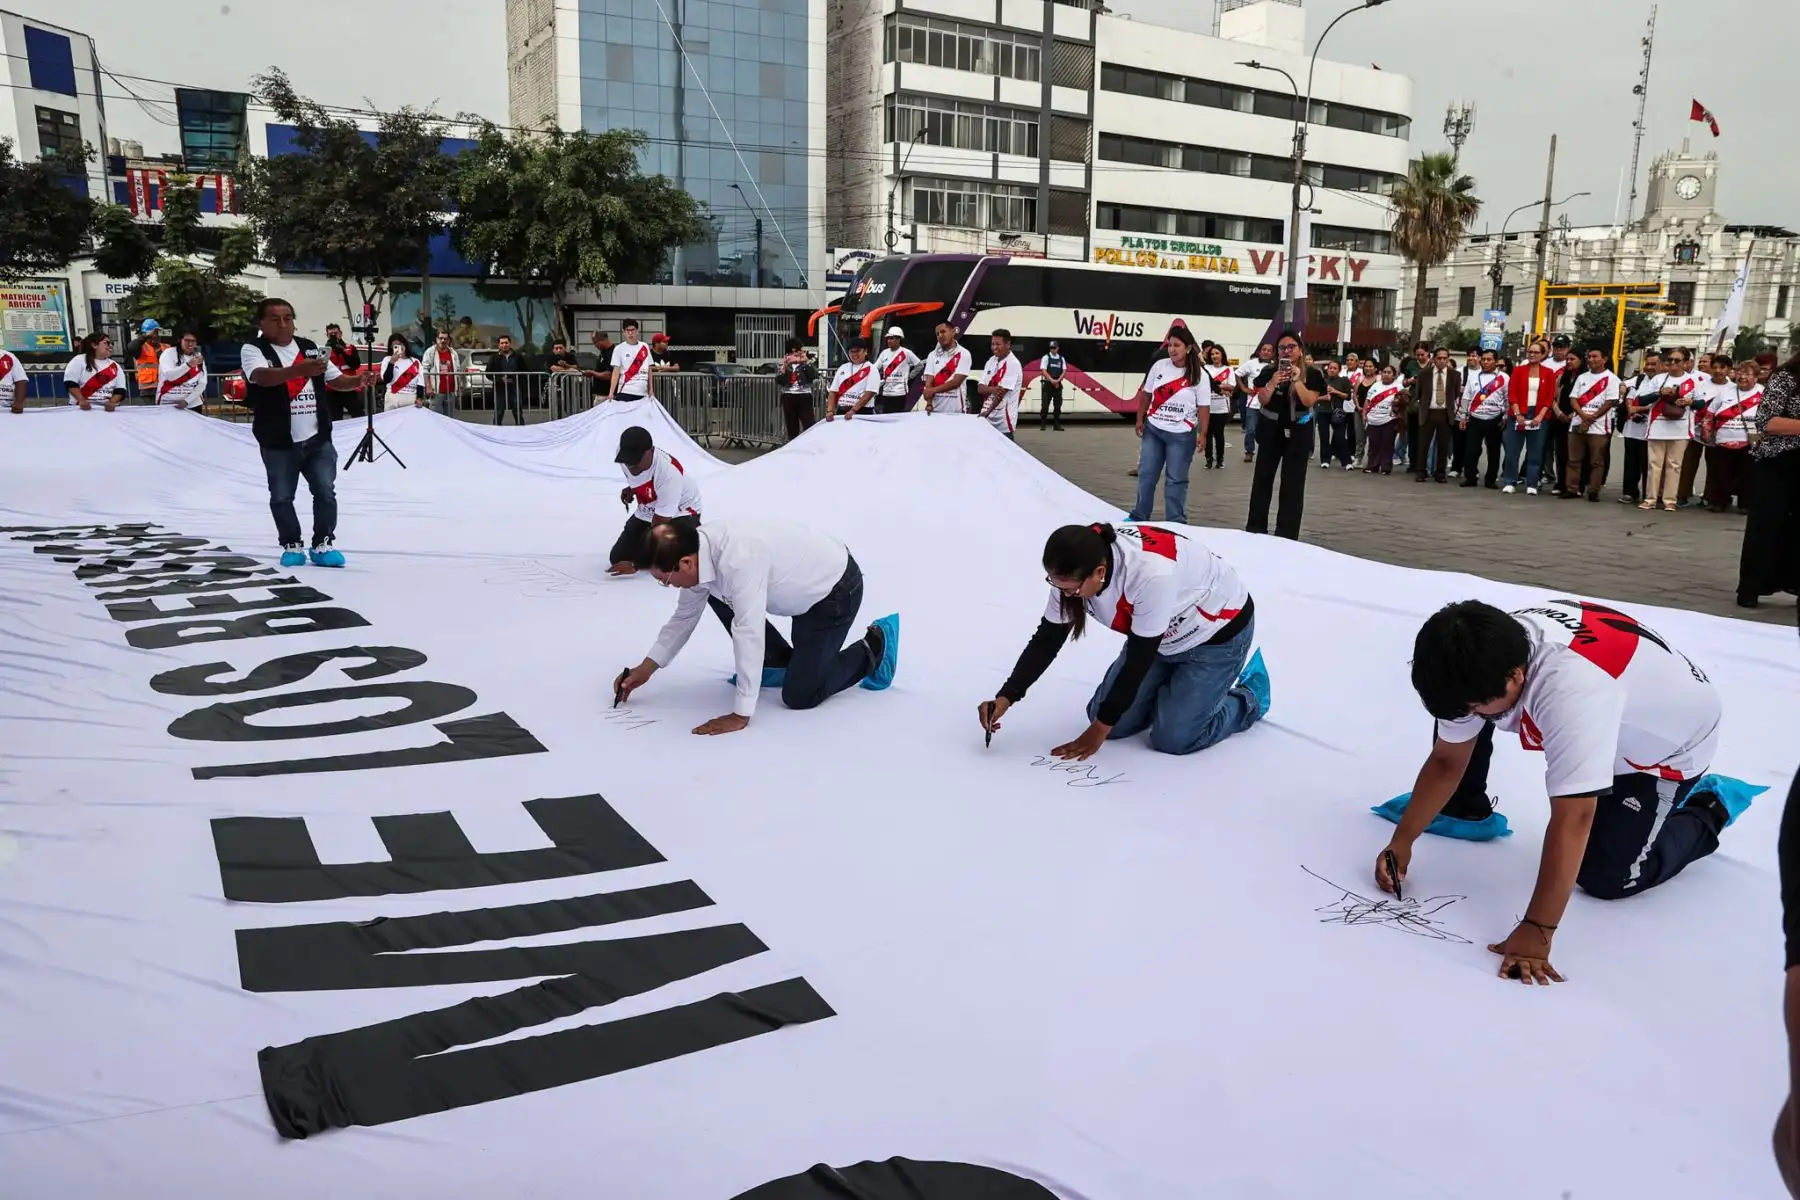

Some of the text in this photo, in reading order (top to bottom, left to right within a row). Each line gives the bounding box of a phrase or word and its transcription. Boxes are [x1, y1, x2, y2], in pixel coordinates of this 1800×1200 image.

[1121, 236, 1222, 256] PLATOS CRIOLLOS
[1095, 247, 1239, 274] POLLOS A LA BRASA
[1, 293, 47, 301] MATRÍCULA
[8, 301, 41, 309] ABIERTA
[1073, 309, 1144, 347] Waybus
[1158, 405, 1185, 413] CTORIA
[150, 645, 549, 780] LOS
[211, 793, 838, 1140] ME
